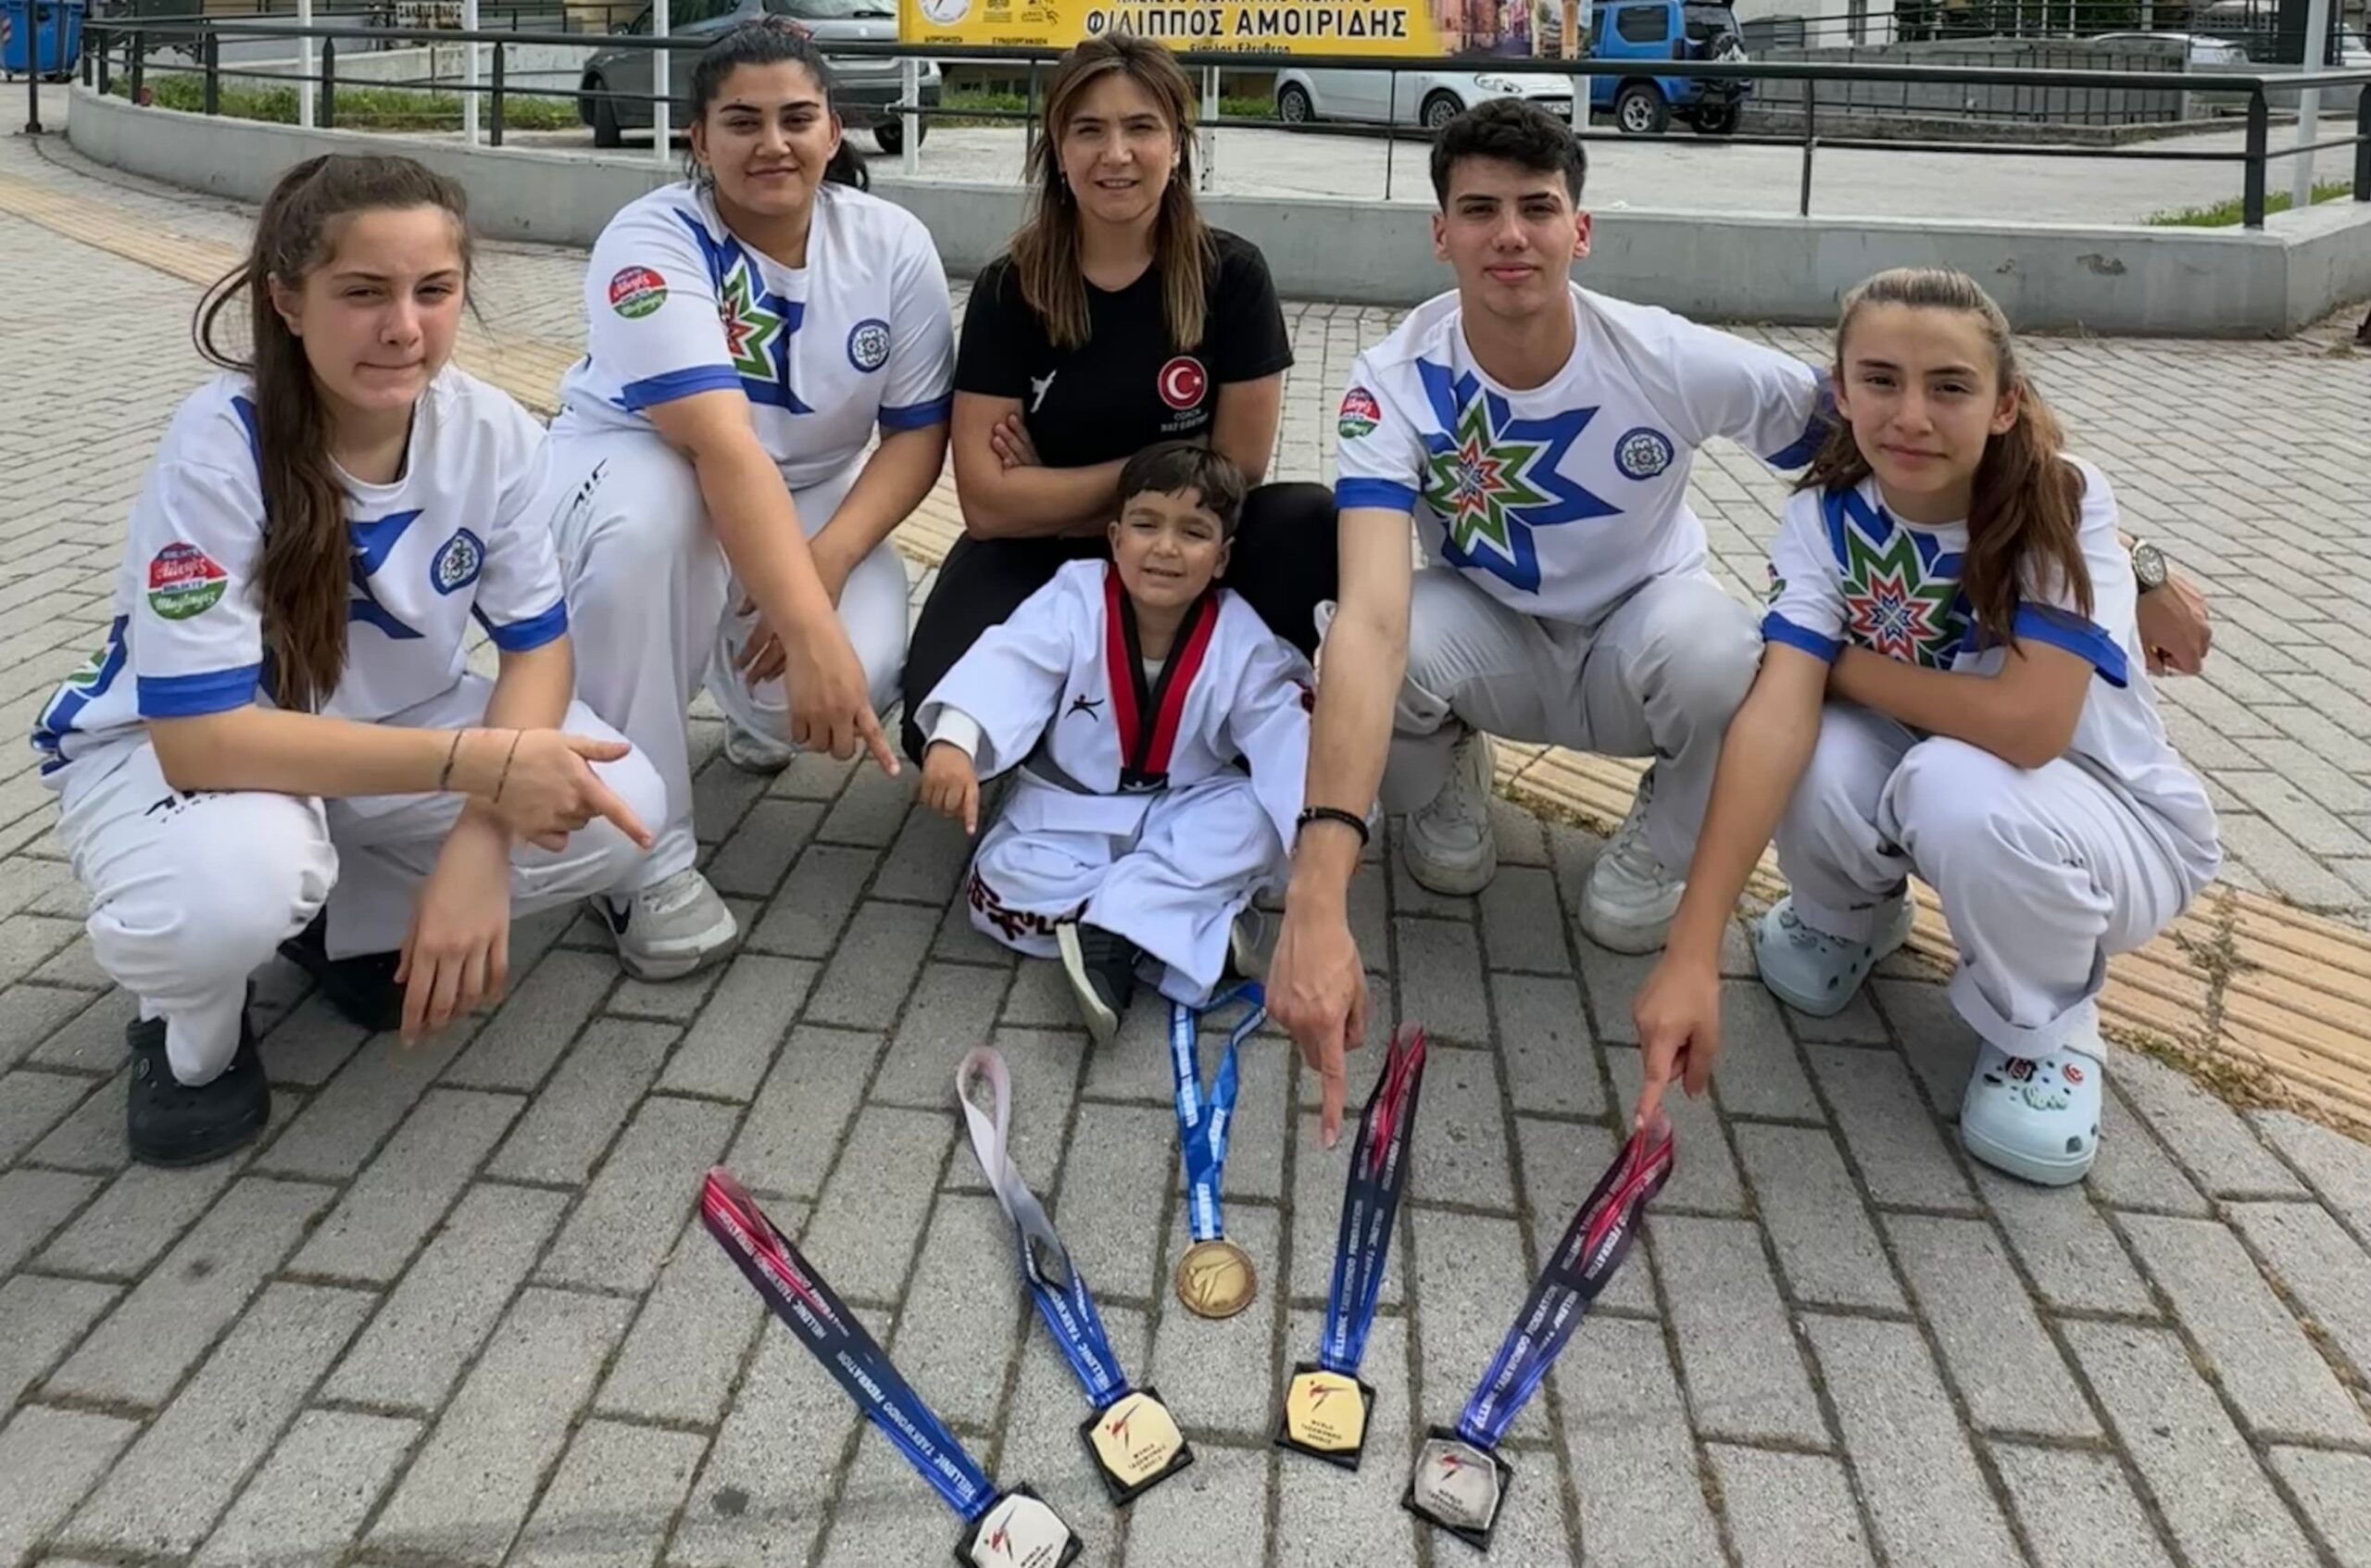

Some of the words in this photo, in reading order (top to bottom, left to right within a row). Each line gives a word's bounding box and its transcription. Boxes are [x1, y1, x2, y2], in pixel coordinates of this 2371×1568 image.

[1087, 9, 1224, 36] ΦΙΛΙΠΠΟΣ
[1236, 9, 1408, 37] ΑΜΟΙΡΙΔΗΣ
[834, 1348, 886, 1403] FEDERATION
[880, 1399, 937, 1456] TAEKWONDO
[932, 1451, 978, 1499] HELLENIC
